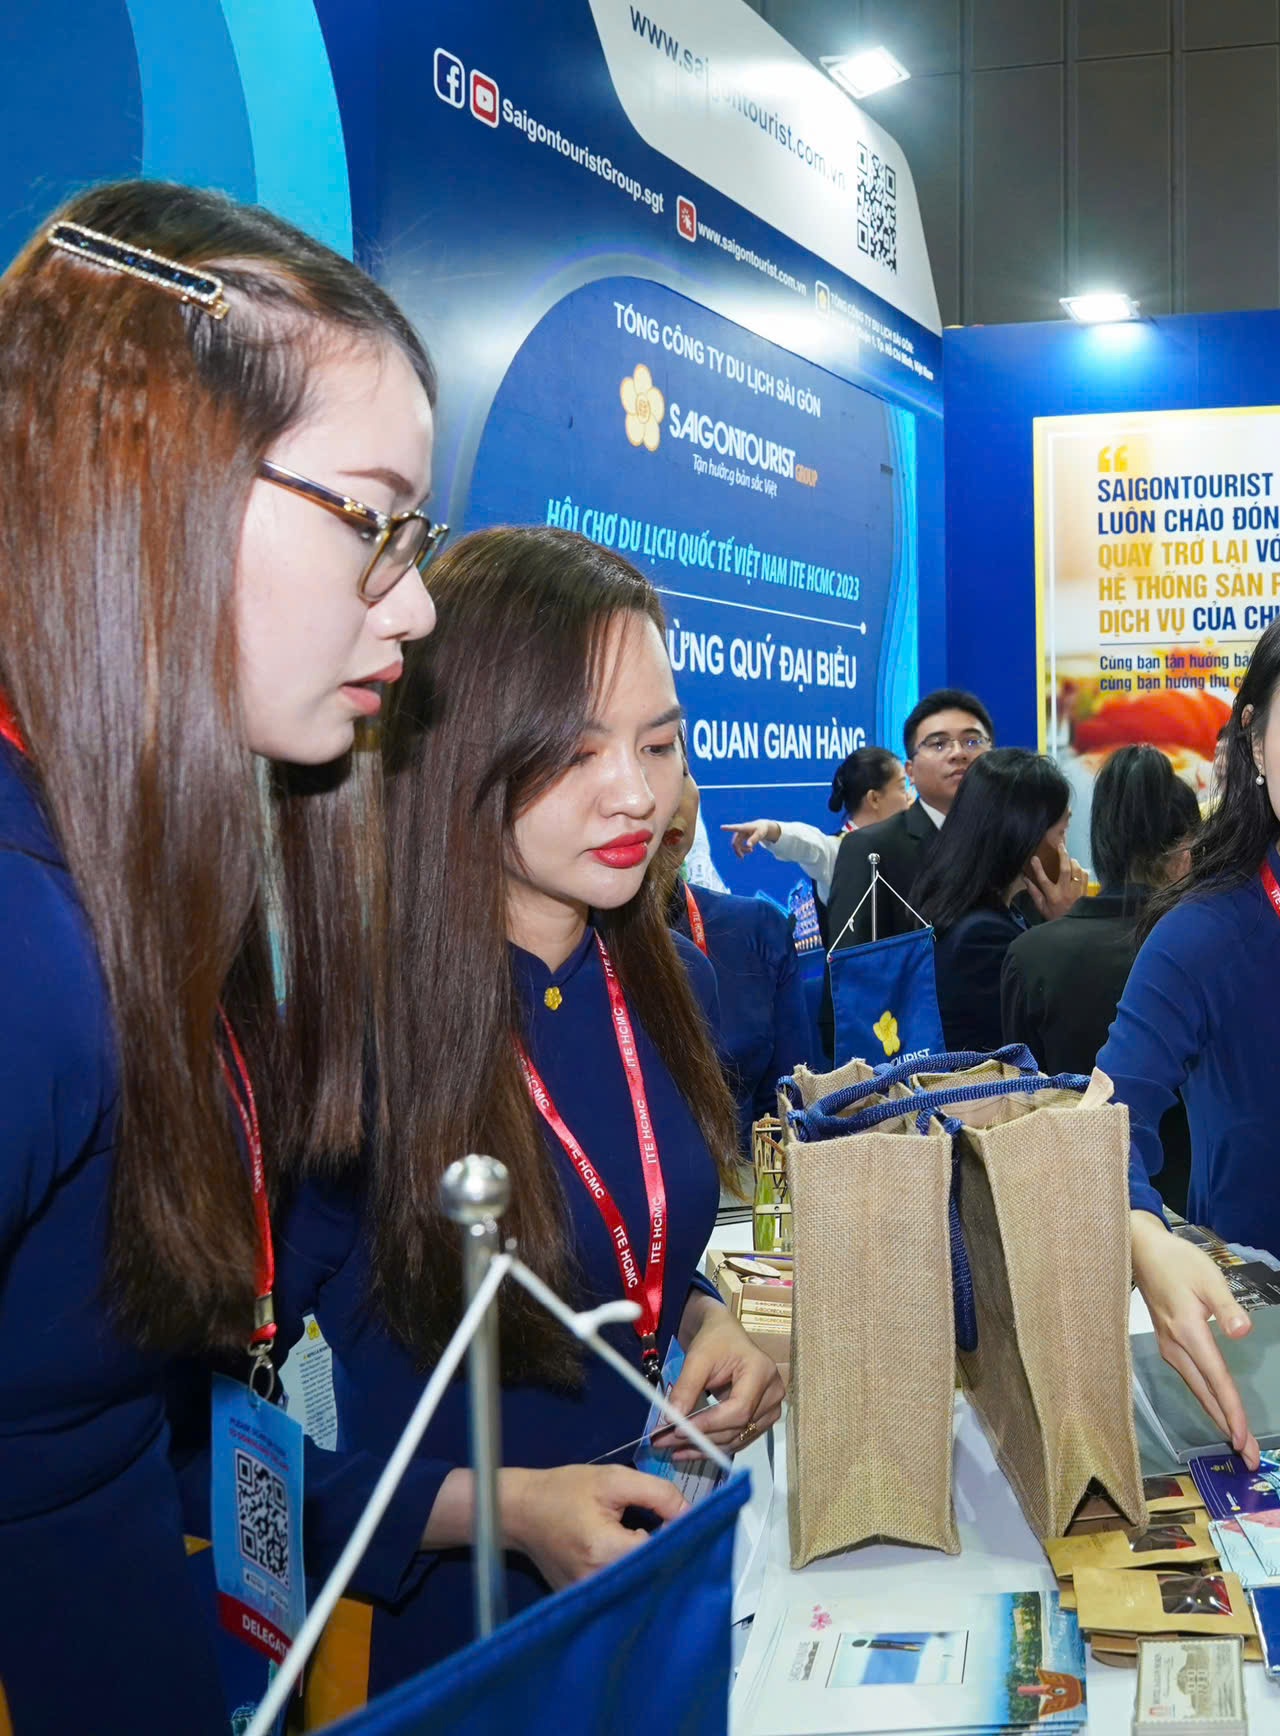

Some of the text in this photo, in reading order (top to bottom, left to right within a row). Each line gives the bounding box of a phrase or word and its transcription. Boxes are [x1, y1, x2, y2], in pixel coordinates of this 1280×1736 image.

[502, 98, 665, 214] SaigontouristGroup.sgt
[697, 221, 807, 297] www.saigontourist.com.vn
[662, 324, 705, 365] CÔNG
[707, 345, 724, 374] TY
[726, 356, 745, 384] DU
[747, 365, 774, 397] LỊCH
[776, 376, 795, 406] SÀI
[797, 386, 821, 418] GÒN
[669, 402, 796, 479] SAIGONTOURIST
[692, 454, 778, 499] Tận hưởng bản sắc Việt
[1097, 473, 1274, 503] SAIGONTOURIST
[1098, 507, 1155, 535] LUÔN
[1164, 504, 1224, 533] CHÀO
[1232, 501, 1279, 530] ĐÓN
[618, 517, 642, 552] DU
[643, 523, 677, 565] LỊCH
[678, 529, 716, 570] QUỐC
[716, 536, 735, 573] TẾ
[733, 544, 761, 585] VIỆT
[762, 556, 787, 586] NAM
[788, 562, 805, 588] ITE
[807, 566, 835, 596] HCMC
[836, 572, 860, 601] 2023
[1098, 543, 1153, 569] QUAY
[1161, 534, 1205, 565] TRỞ
[1212, 539, 1248, 568] LẠI
[1098, 575, 1127, 604] HỆ
[1133, 570, 1207, 600] THỐNG
[1215, 566, 1264, 598] SẢN
[1099, 608, 1149, 637] DỊCH
[1157, 607, 1185, 636] VỤ
[1192, 601, 1237, 631] CỦA
[667, 618, 857, 692] ỪNG QUÝ ĐẠI BIỂU
[1100, 654, 1133, 671] Cùng
[1137, 655, 1160, 673] bạn
[1165, 654, 1184, 672] tận
[1189, 652, 1229, 669] hưởng
[1137, 675, 1160, 693] bạn
[1165, 672, 1205, 690] hưởng
[1209, 674, 1230, 691] thụ
[693, 719, 759, 761] QUAN
[763, 722, 812, 760] GIAN
[815, 717, 866, 760] HÀNG
[613, 1007, 637, 1068] ITE HCMC
[637, 1099, 657, 1164] ITE HCMC
[566, 1139, 605, 1199] ITE HCMC
[613, 1225, 638, 1289] ITE HCMC
[650, 1196, 663, 1264] ITE HCMC
[242, 1614, 289, 1657] DELEGAT
